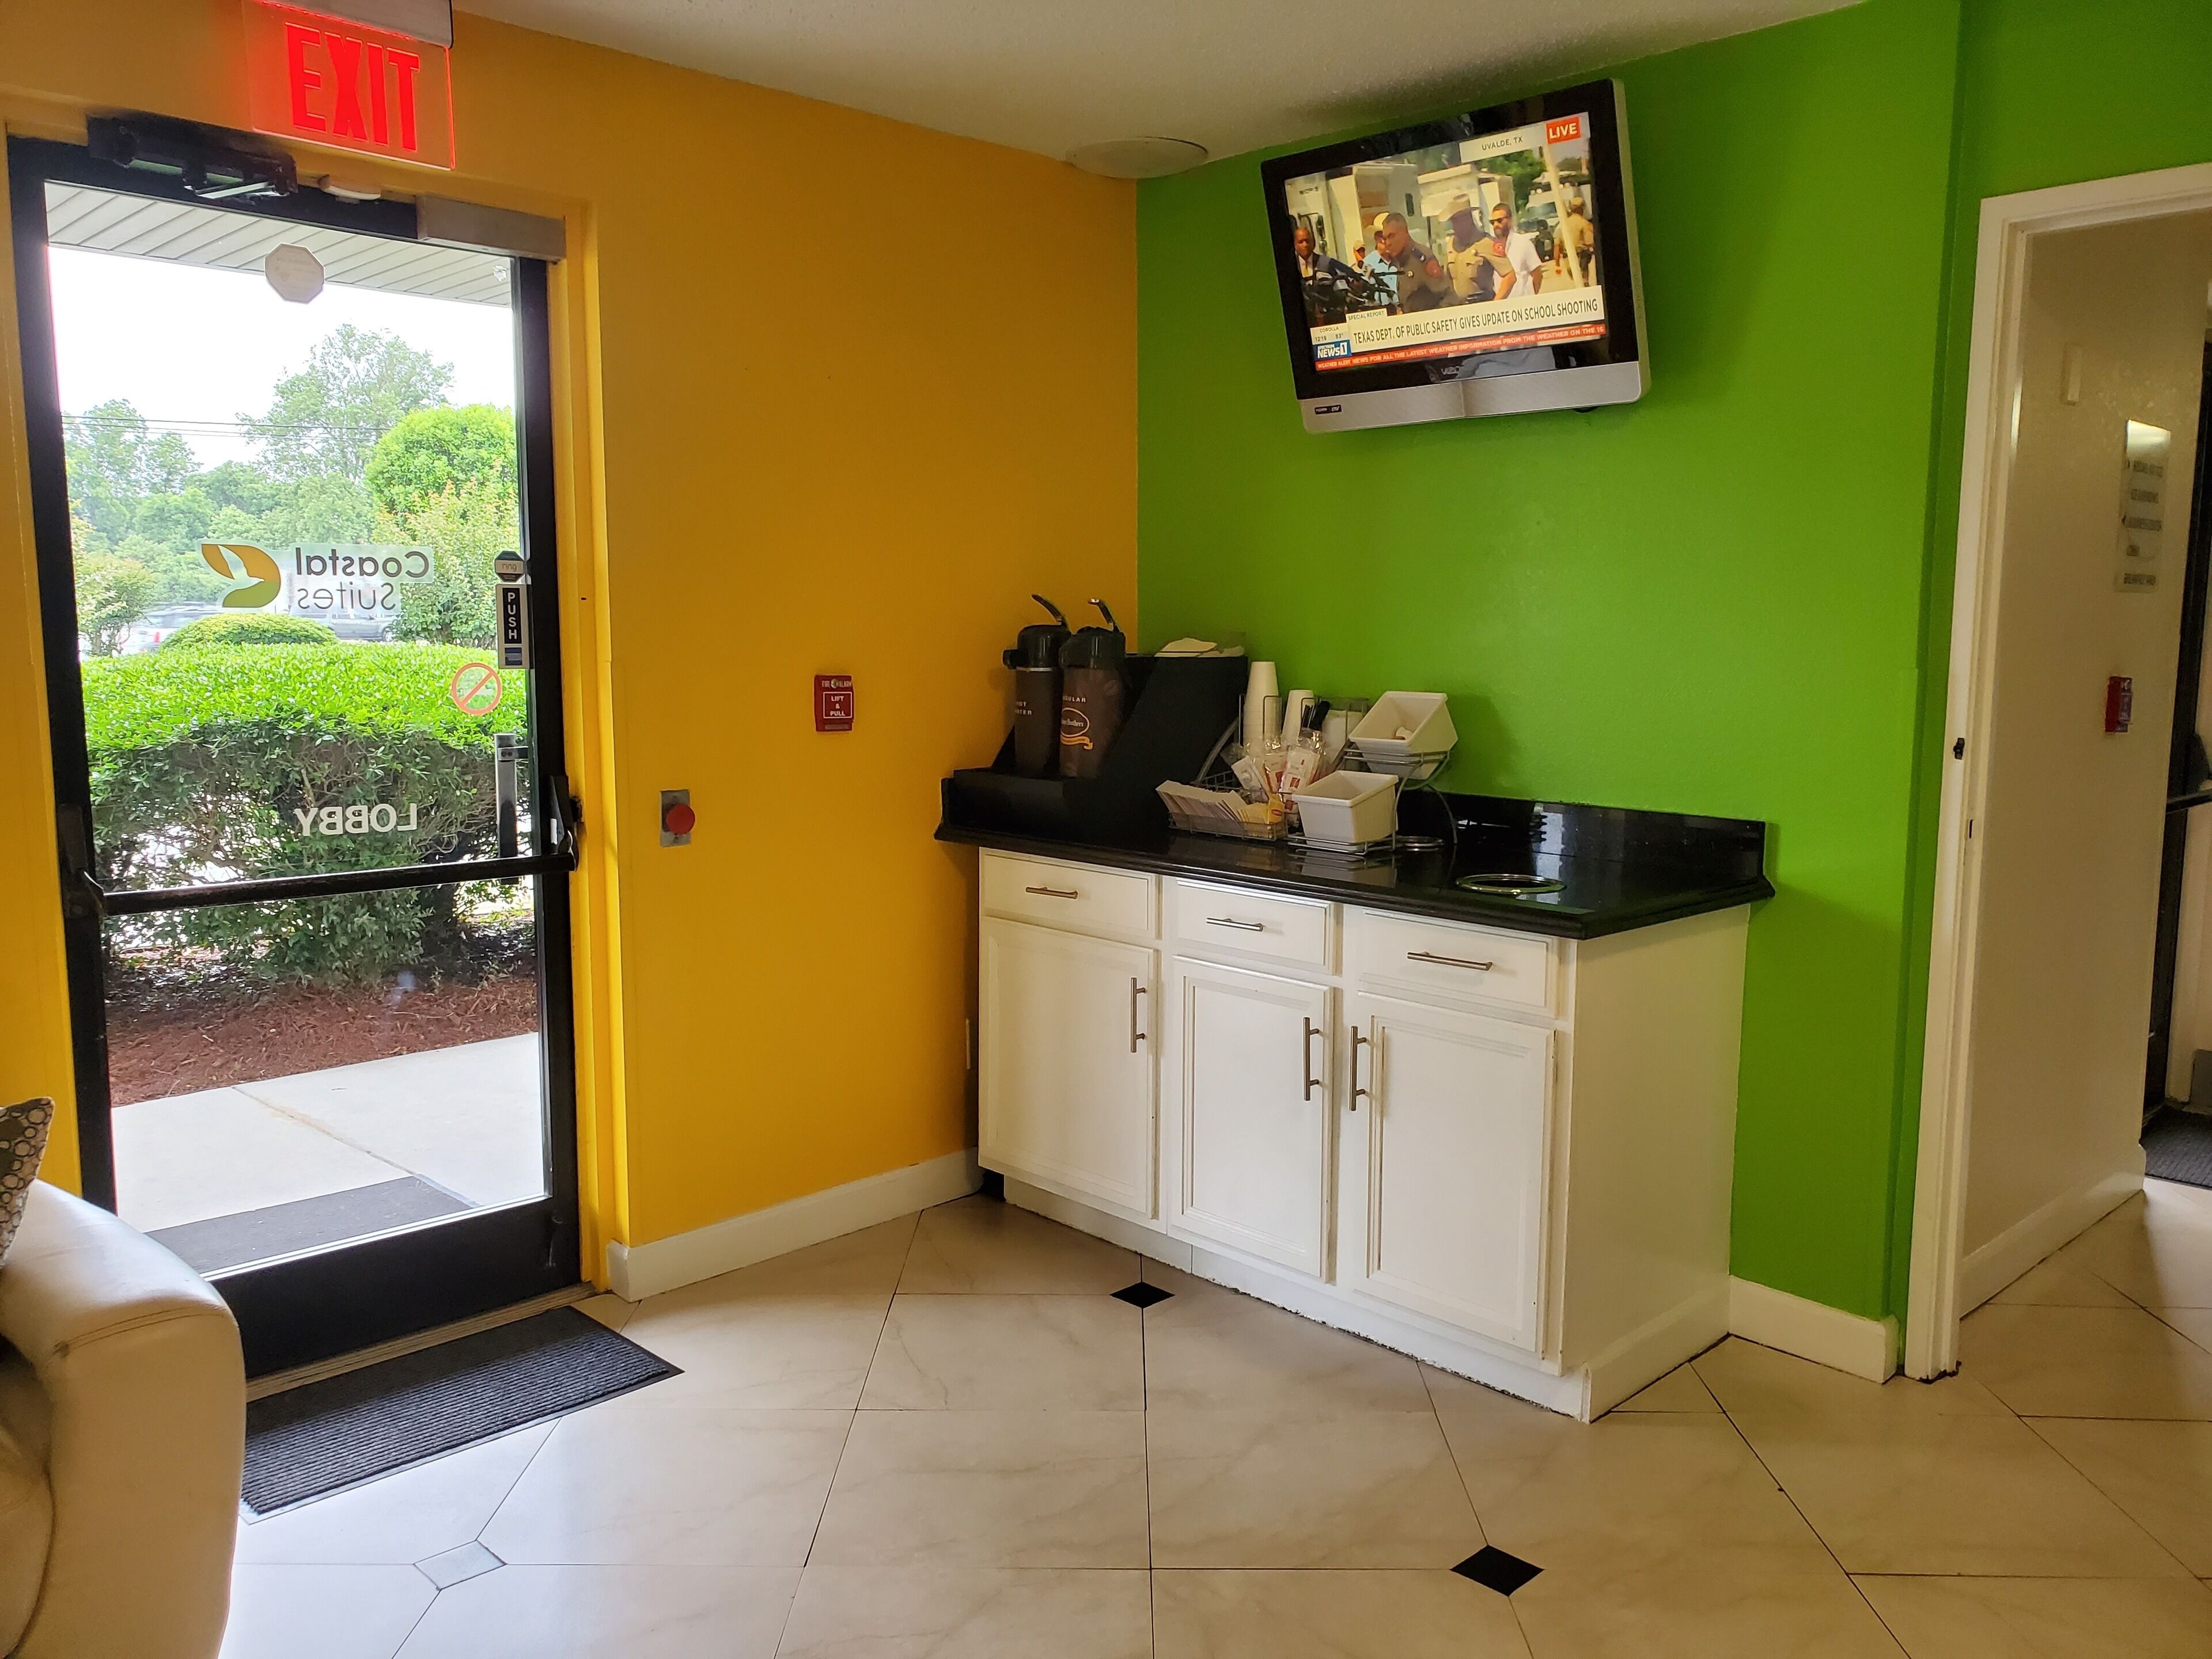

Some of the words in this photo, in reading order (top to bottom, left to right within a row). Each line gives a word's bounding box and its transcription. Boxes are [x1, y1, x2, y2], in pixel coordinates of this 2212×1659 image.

[285, 22, 420, 152] EXIT
[1482, 139, 1512, 151] UVALDE,
[1549, 123, 1577, 139] LIVE
[1353, 328, 1374, 344] TEXAS
[1376, 327, 1395, 341] DEPT.
[1396, 326, 1405, 338] OF
[1406, 322, 1431, 336] PUBLIC
[1432, 318, 1457, 333] SAFETY
[1459, 315, 1480, 329] GIVES
[1482, 311, 1510, 326] UPDATE
[1512, 309, 1522, 321] ON
[1524, 304, 1555, 320] SCHOOL
[1557, 298, 1598, 316] SHOOTING
[1406, 349, 1428, 357] LATEST
[1429, 344, 1457, 354] WEATHER
[1459, 339, 1502, 350] INFORMATION
[1503, 336, 1521, 344] FROM
[1536, 330, 1569, 340] WEATHER
[507, 592, 517, 639] PUSH
